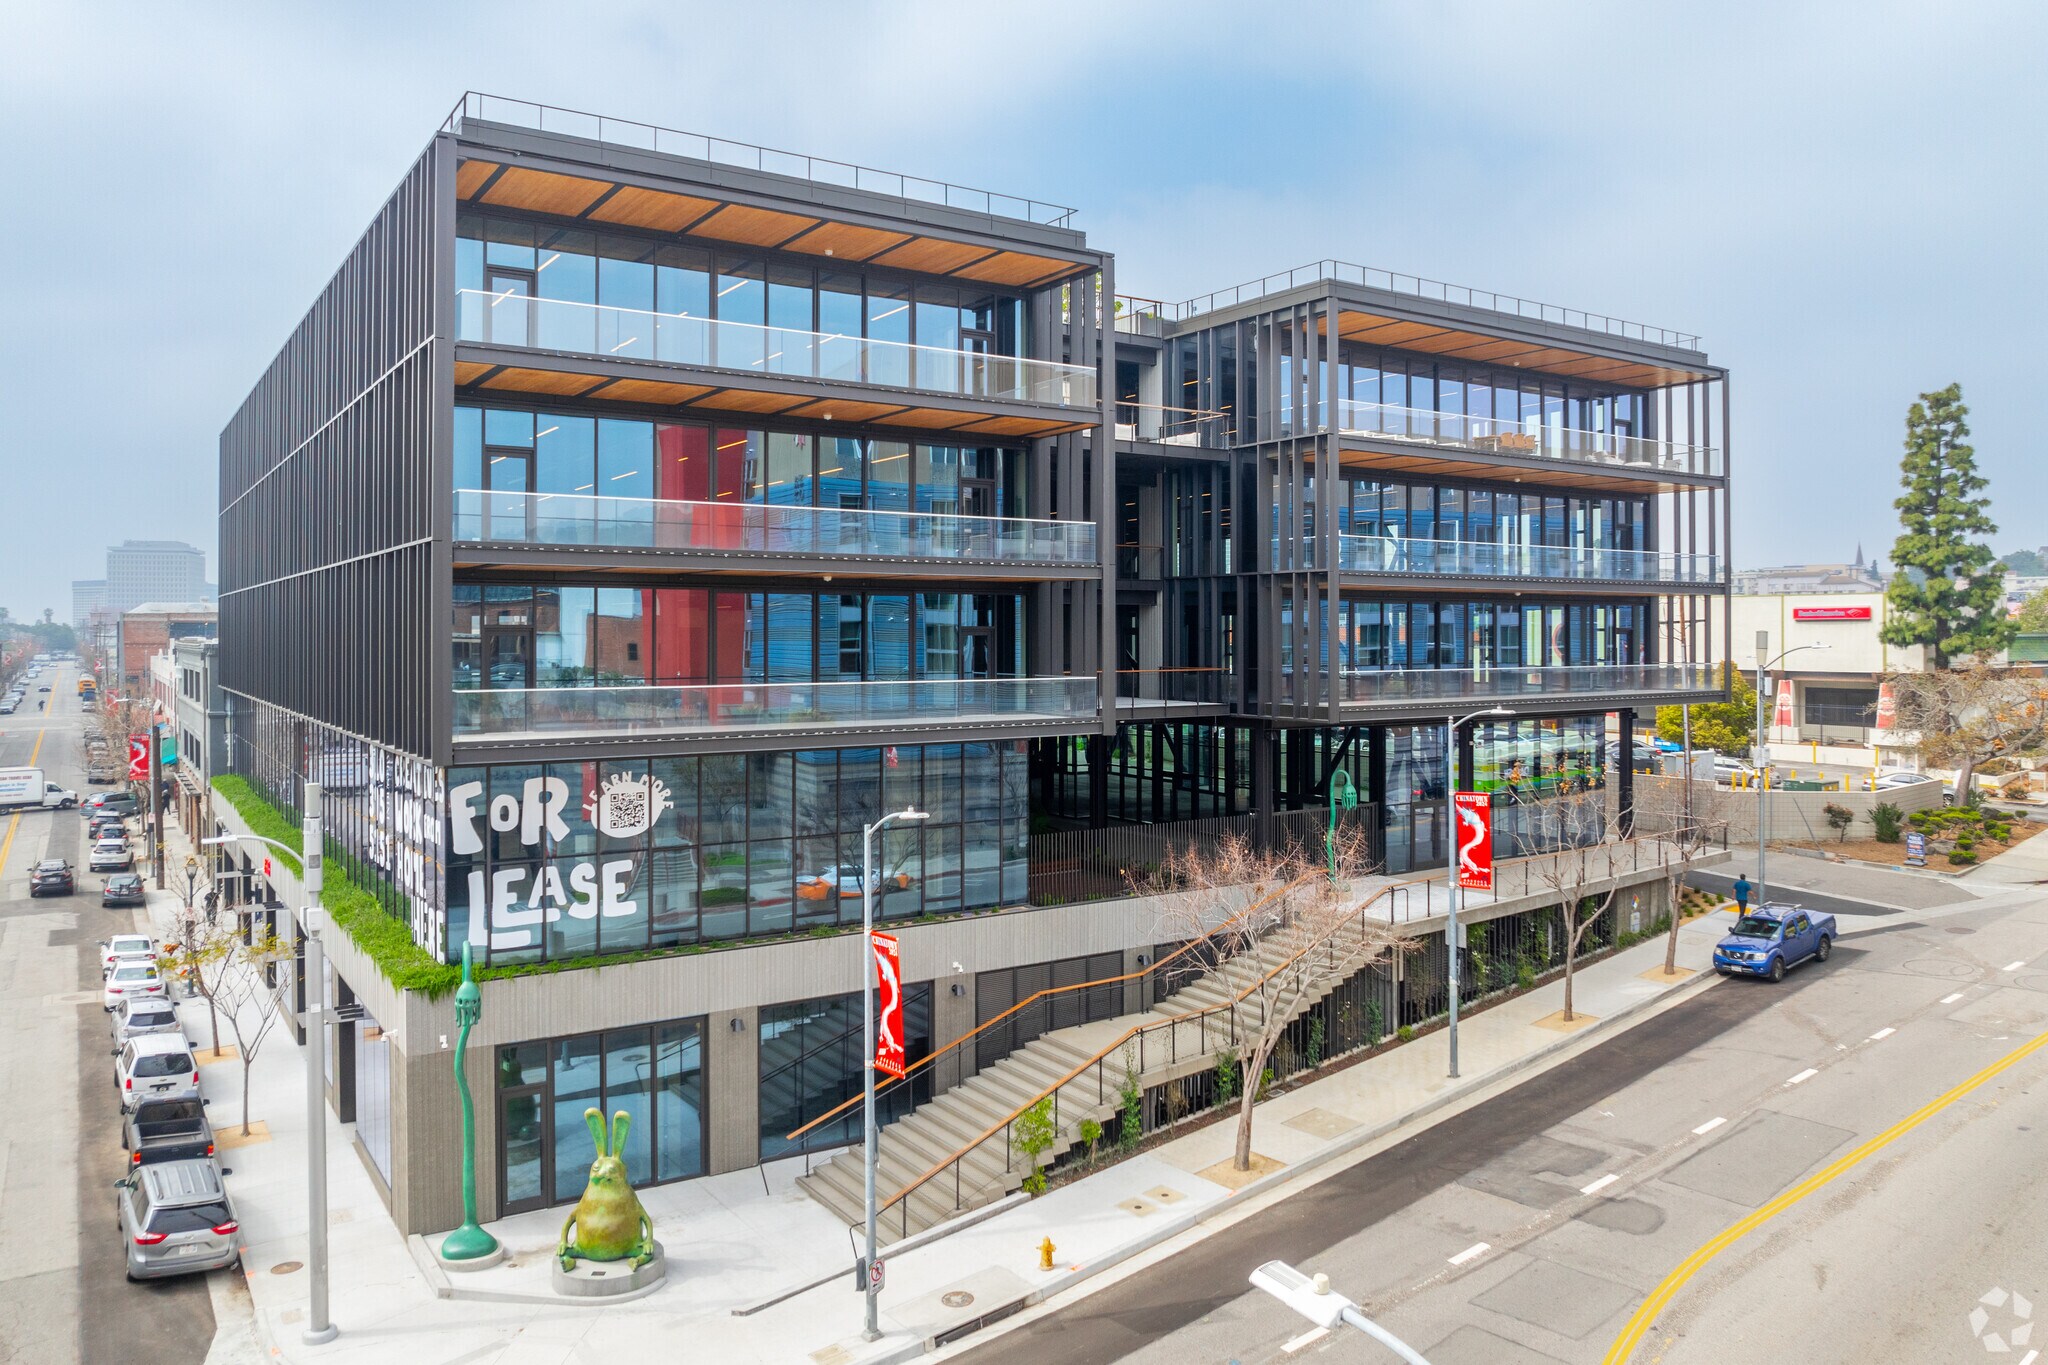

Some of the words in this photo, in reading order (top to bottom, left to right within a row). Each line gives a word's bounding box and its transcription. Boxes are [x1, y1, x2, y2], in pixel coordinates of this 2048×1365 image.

[394, 790, 423, 845] WORK
[582, 771, 633, 811] LEARN
[640, 774, 674, 809] MORE
[411, 893, 446, 965] HERE
[467, 859, 638, 950] LEASE
